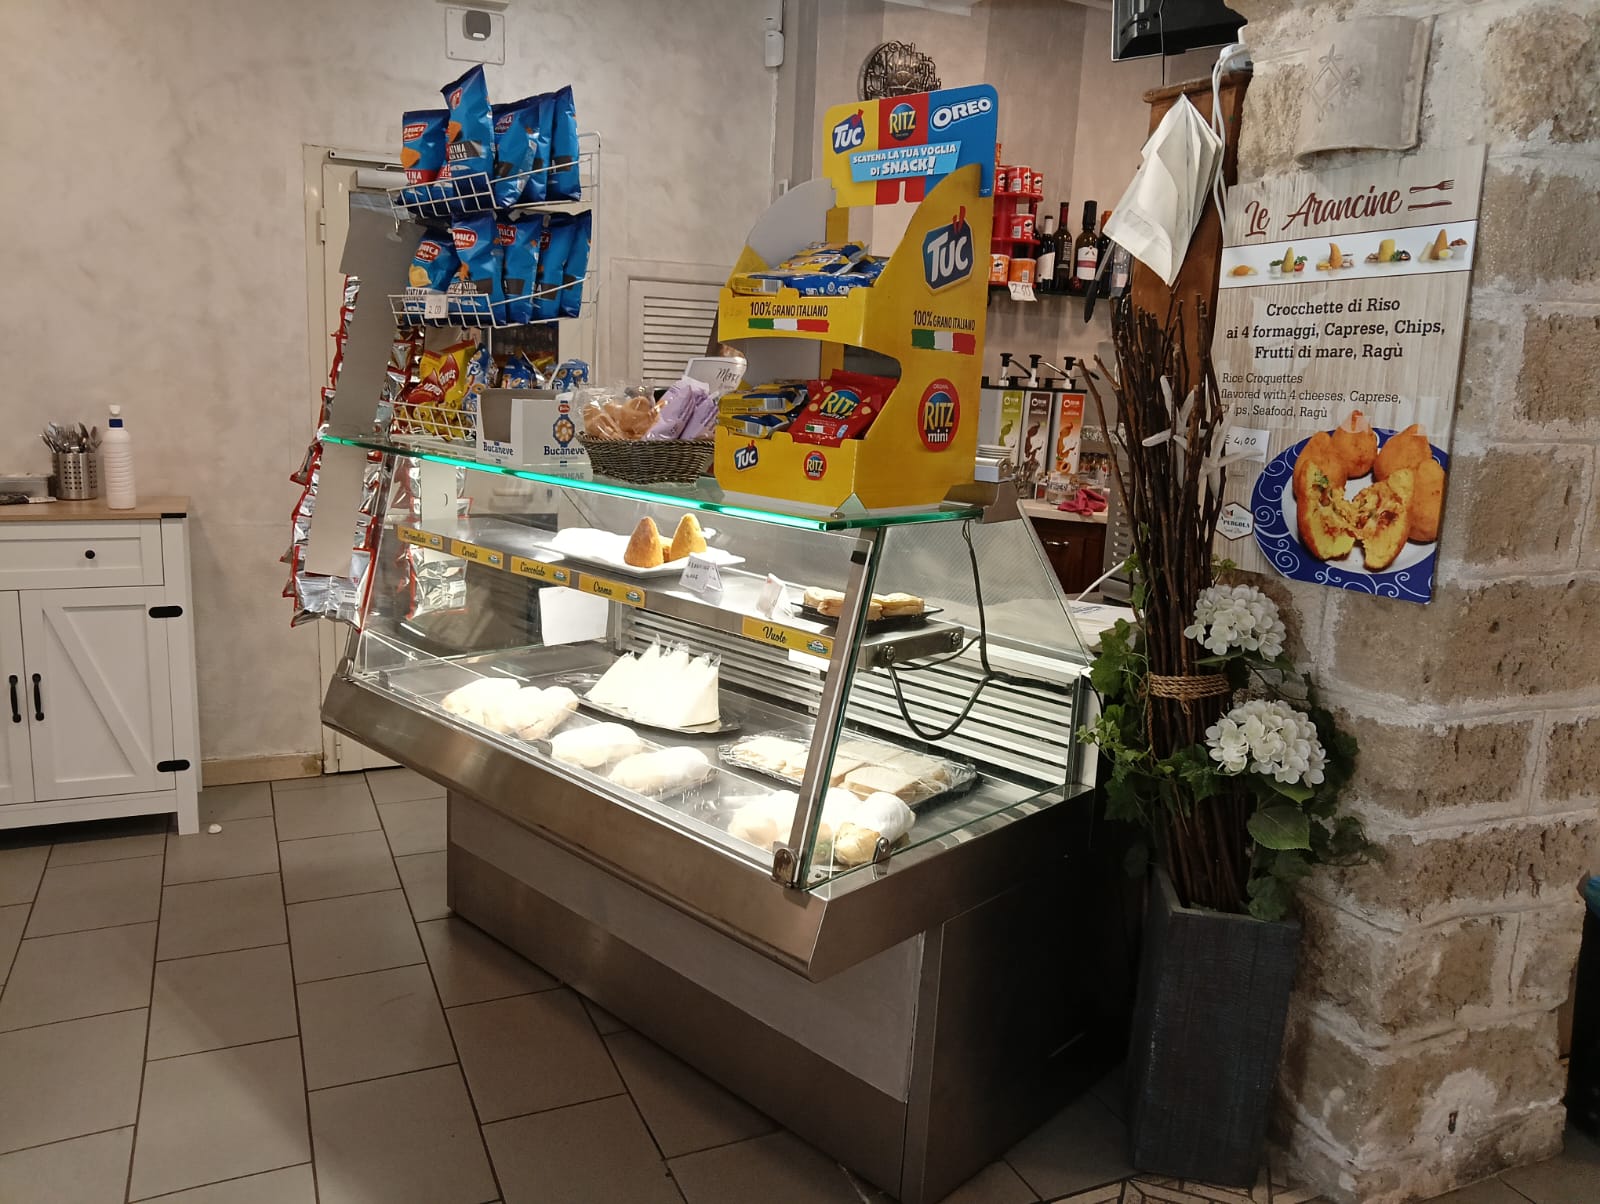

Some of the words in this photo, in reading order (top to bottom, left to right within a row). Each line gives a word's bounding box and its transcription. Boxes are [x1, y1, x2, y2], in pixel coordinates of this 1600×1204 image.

[889, 111, 917, 134] RITZ
[932, 98, 992, 128] OREO
[833, 123, 863, 149] TUC
[853, 153, 886, 164] SCATENA
[888, 151, 899, 160] LA
[900, 148, 919, 158] TUA
[920, 144, 956, 155] VOGLIA
[870, 166, 880, 176] DI
[882, 156, 937, 175] SNACK!
[1244, 200, 1271, 238] Le
[1281, 185, 1403, 231] Arancine
[927, 232, 969, 282] TUC
[750, 301, 771, 317] 100%
[772, 304, 796, 317] GRANO
[796, 304, 829, 317] ITALIANO
[1266, 301, 1343, 317] Crocchette
[1348, 299, 1362, 313] di
[1367, 297, 1401, 312] Riso
[913, 310, 933, 327] 100%
[933, 315, 951, 329] GRANO
[951, 316, 976, 331] ITALIANO
[1226, 326, 1239, 339] ai
[1241, 325, 1250, 339] 4
[1252, 323, 1319, 340] formaggi,
[1324, 322, 1389, 338] Caprese,
[1394, 319, 1446, 336] Chips,
[1254, 345, 1294, 359] Frutti
[1298, 344, 1312, 358] di
[1315, 346, 1357, 360] mare,
[1362, 342, 1403, 361] Ragù
[1222, 373, 1243, 384] Rice
[1246, 373, 1303, 386] Croquettes
[820, 391, 859, 416] RITZ
[1220, 389, 1260, 400] flavored
[1263, 389, 1287, 401] with
[1289, 390, 1296, 401] 4
[1299, 390, 1346, 402] cheeses,
[1350, 390, 1401, 404] Caprese,
[924, 401, 955, 428] RITZ
[1220, 404, 1250, 417] Cps,
[1252, 404, 1296, 418] Seafood,
[1300, 406, 1328, 420] Ragù
[927, 430, 949, 444] mini
[483, 442, 514, 456] Bucaneve
[543, 445, 585, 456] Bucaneve
[735, 449, 757, 468] TUC
[807, 459, 824, 472] RITZ
[1223, 520, 1250, 529] PERGOLA
[520, 561, 546, 577] Cioccolato
[593, 581, 613, 596] Crema
